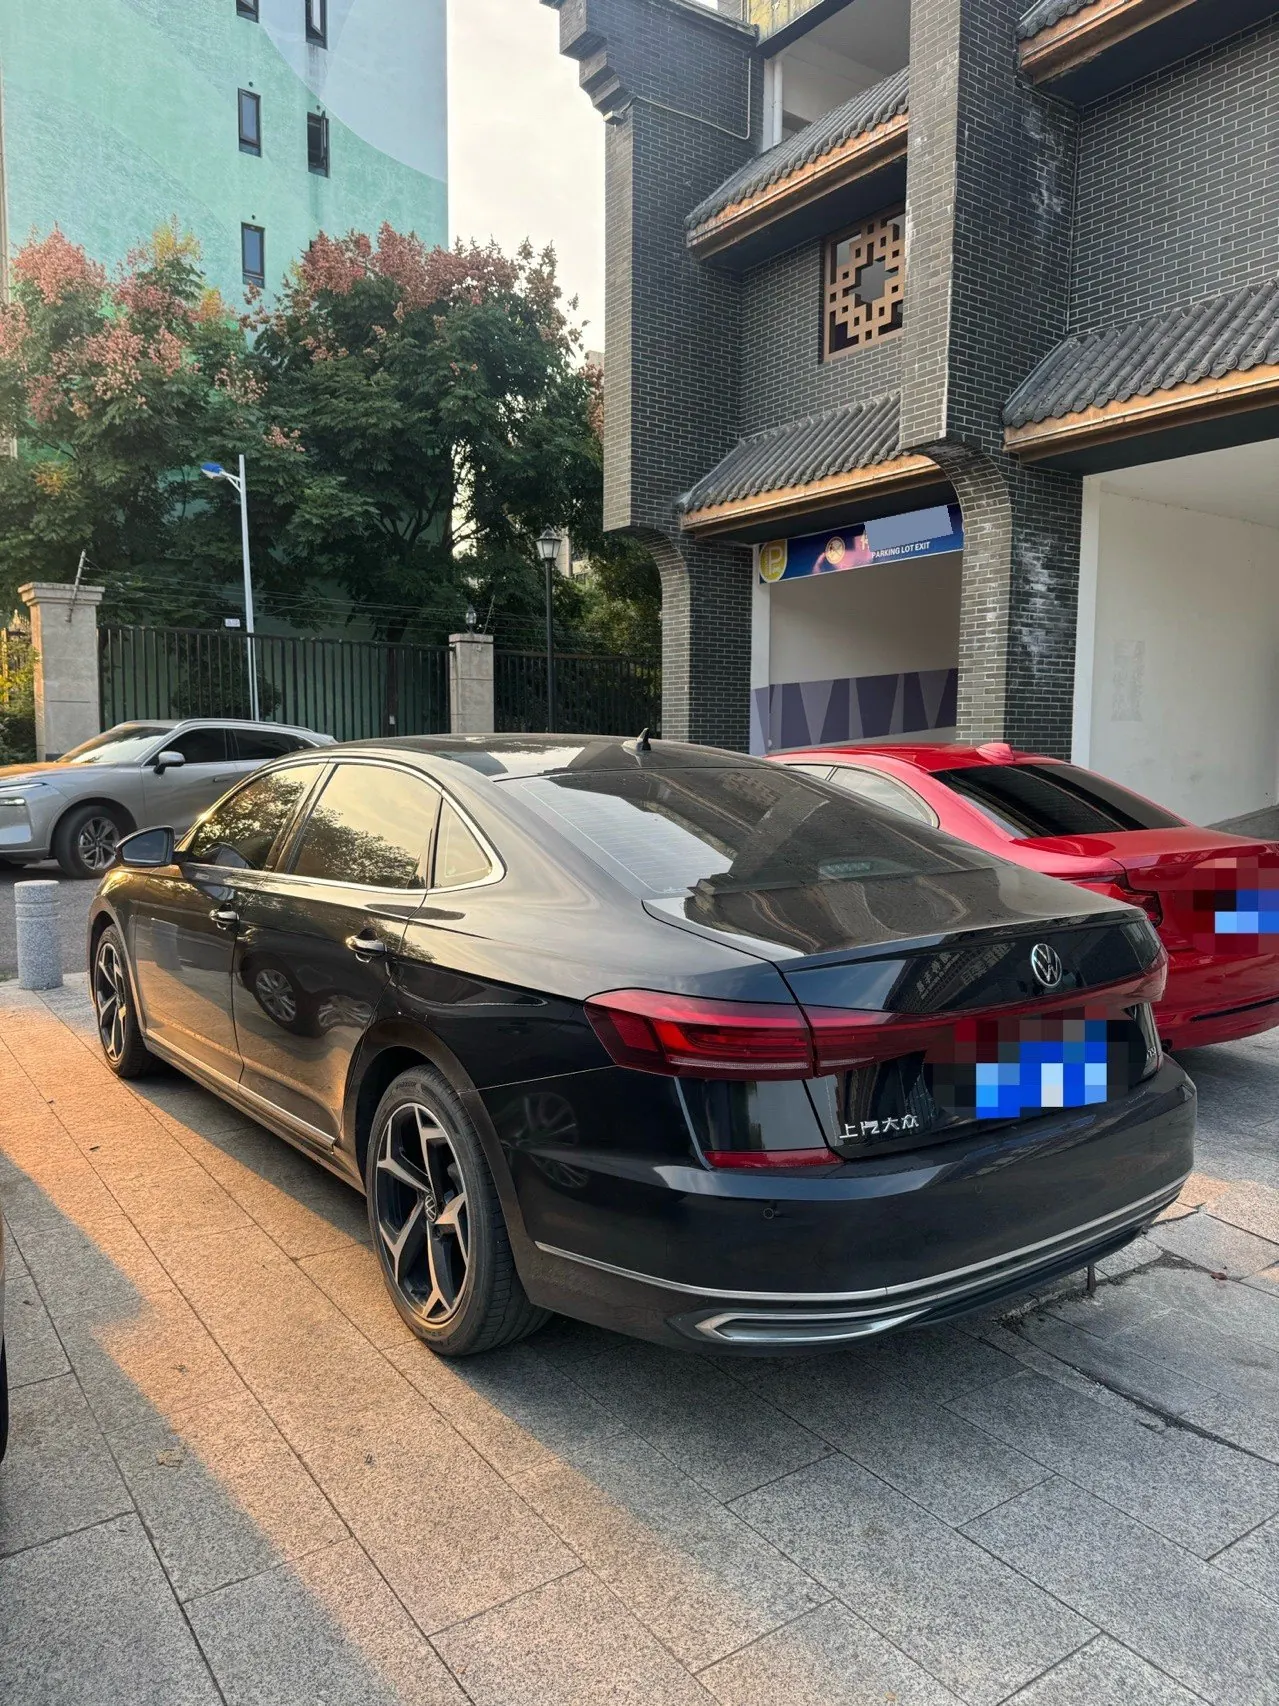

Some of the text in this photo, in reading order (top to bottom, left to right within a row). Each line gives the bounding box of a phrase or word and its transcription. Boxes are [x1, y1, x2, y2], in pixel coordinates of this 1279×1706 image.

[871, 541, 931, 559] PARKING LOT EXIT
[839, 1113, 920, 1140] 上汽大众
